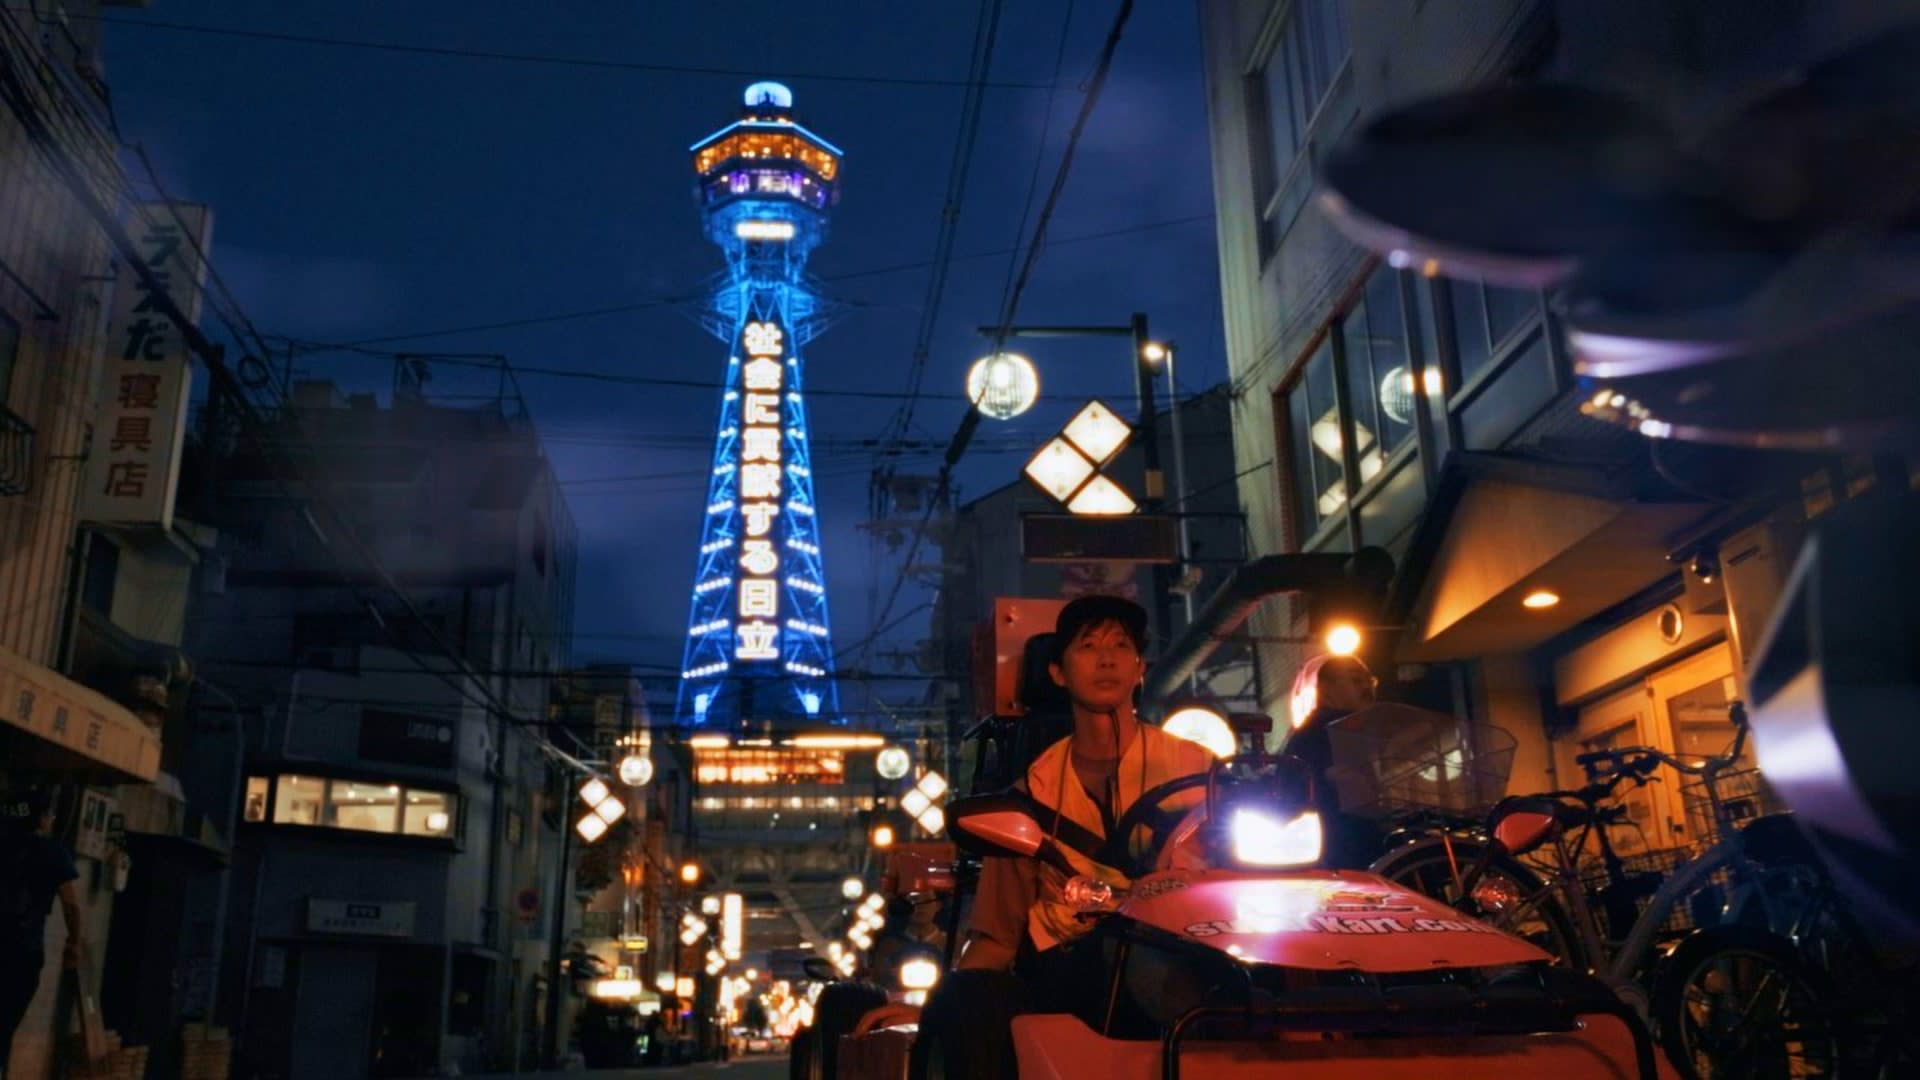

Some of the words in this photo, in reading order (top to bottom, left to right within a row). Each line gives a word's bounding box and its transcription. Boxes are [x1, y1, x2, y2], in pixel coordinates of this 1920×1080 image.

[736, 320, 784, 660] 社会に貢献する日立
